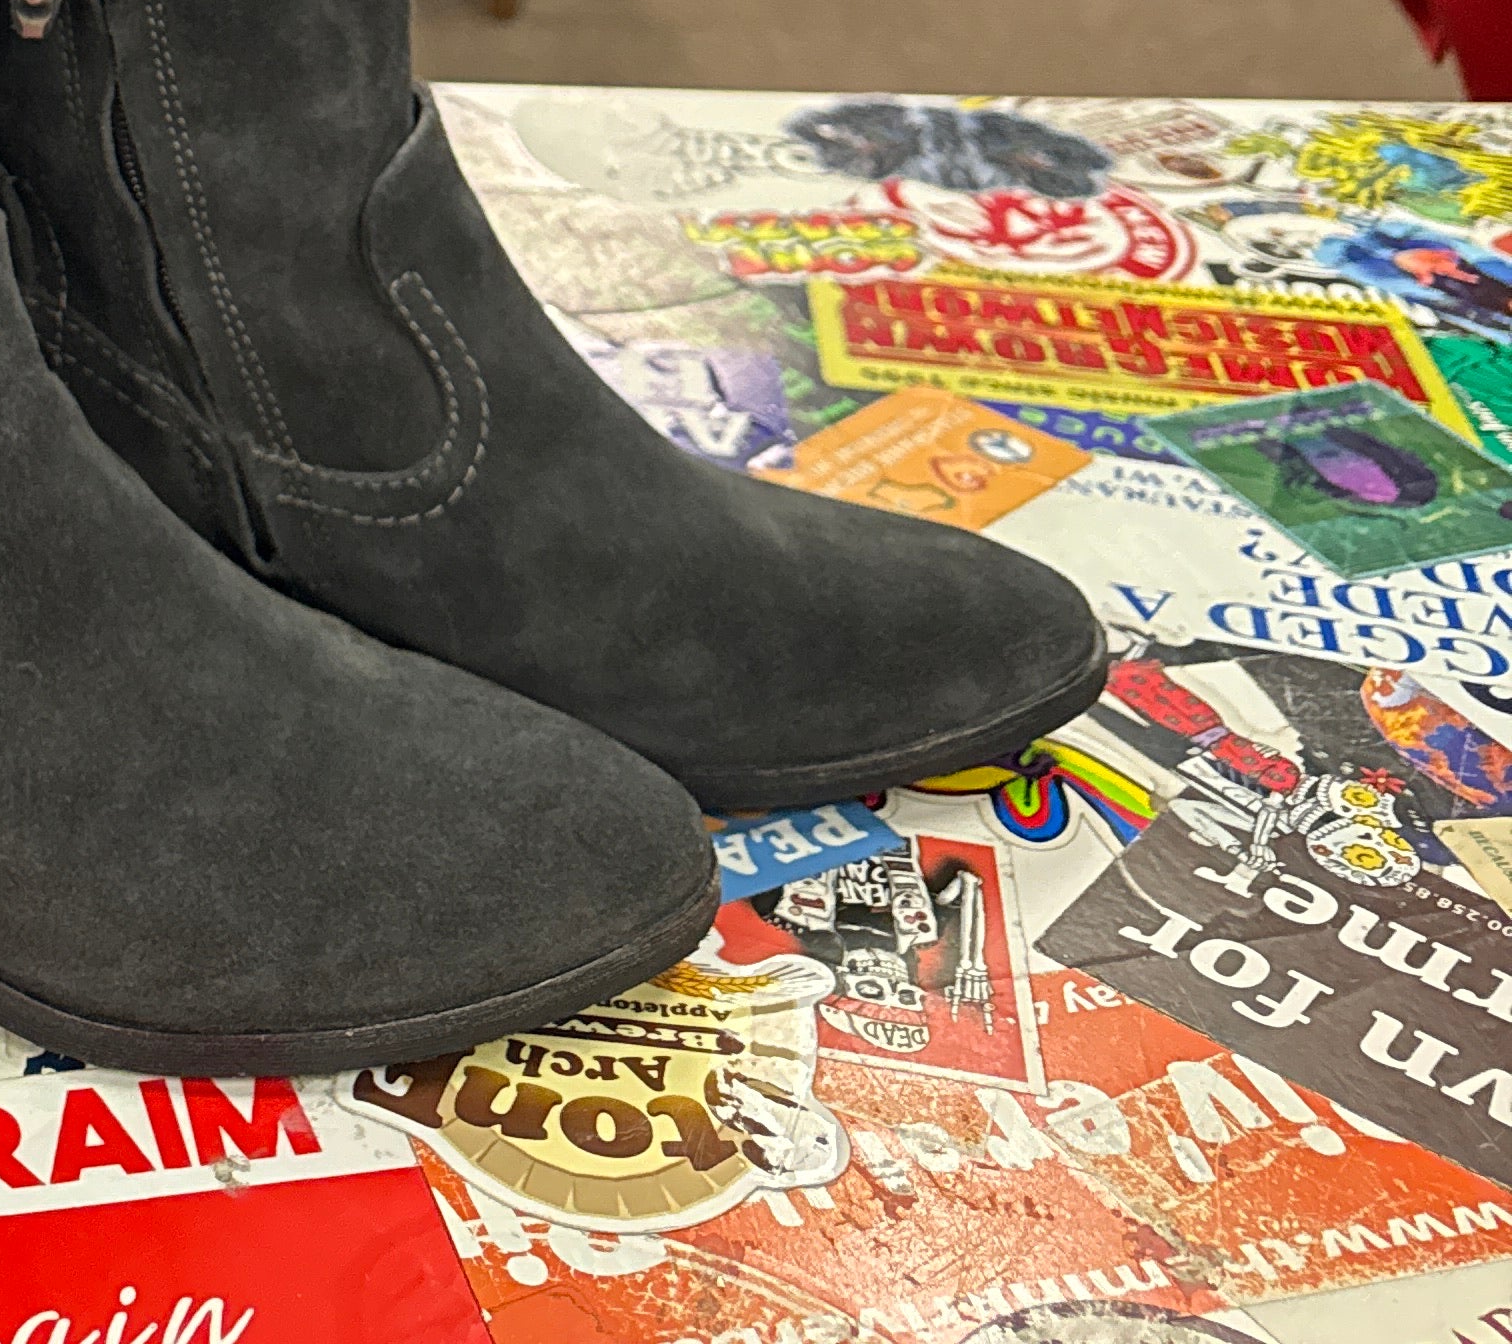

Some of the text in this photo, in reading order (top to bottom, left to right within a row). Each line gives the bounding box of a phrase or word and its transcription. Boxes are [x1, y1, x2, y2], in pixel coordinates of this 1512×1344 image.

[1108, 581, 1176, 623] A
[1119, 909, 1336, 1027] for
[862, 1021, 927, 1048] DEAD
[506, 1039, 672, 1093] Arch
[453, 1066, 740, 1172] ton
